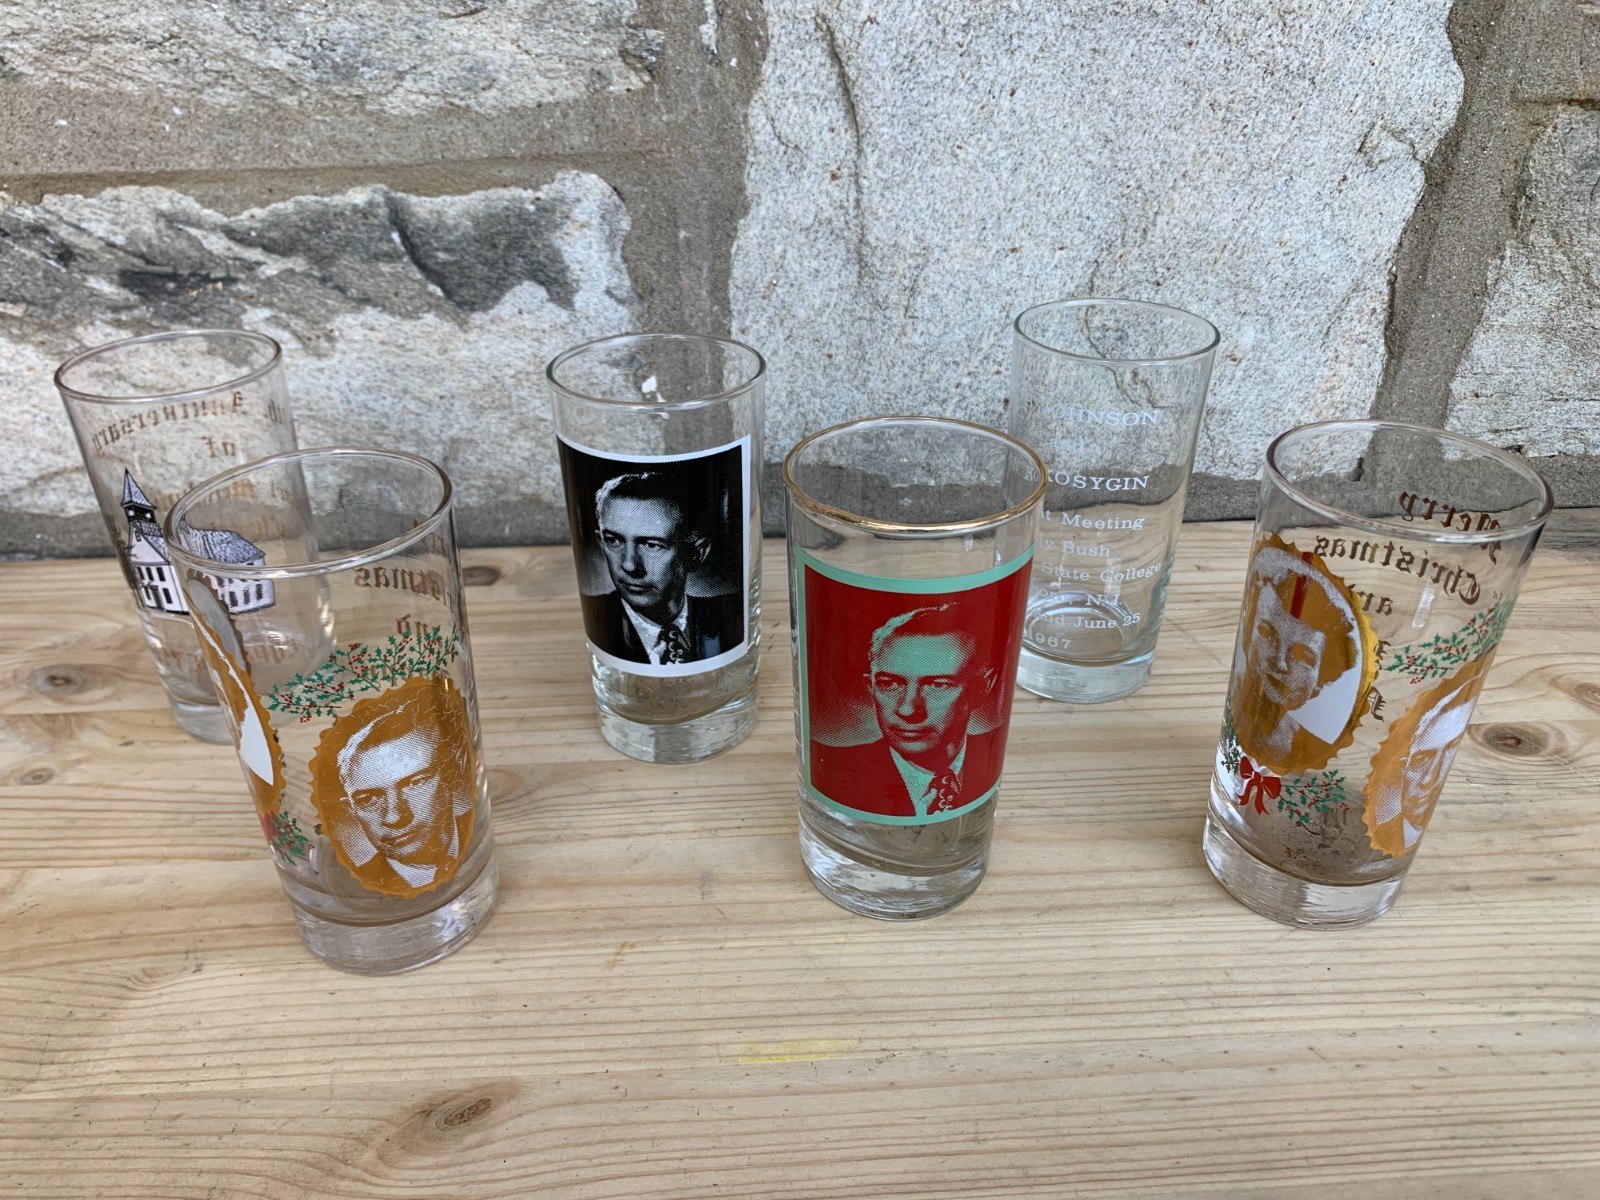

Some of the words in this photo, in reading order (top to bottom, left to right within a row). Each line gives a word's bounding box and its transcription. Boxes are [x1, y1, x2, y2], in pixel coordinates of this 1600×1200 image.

[1061, 512, 1145, 531] Meeting
[1061, 540, 1110, 557] Bush
[1041, 561, 1090, 581] State
[1100, 562, 1162, 582] College
[1073, 616, 1117, 629] June
[1123, 613, 1141, 626] 25
